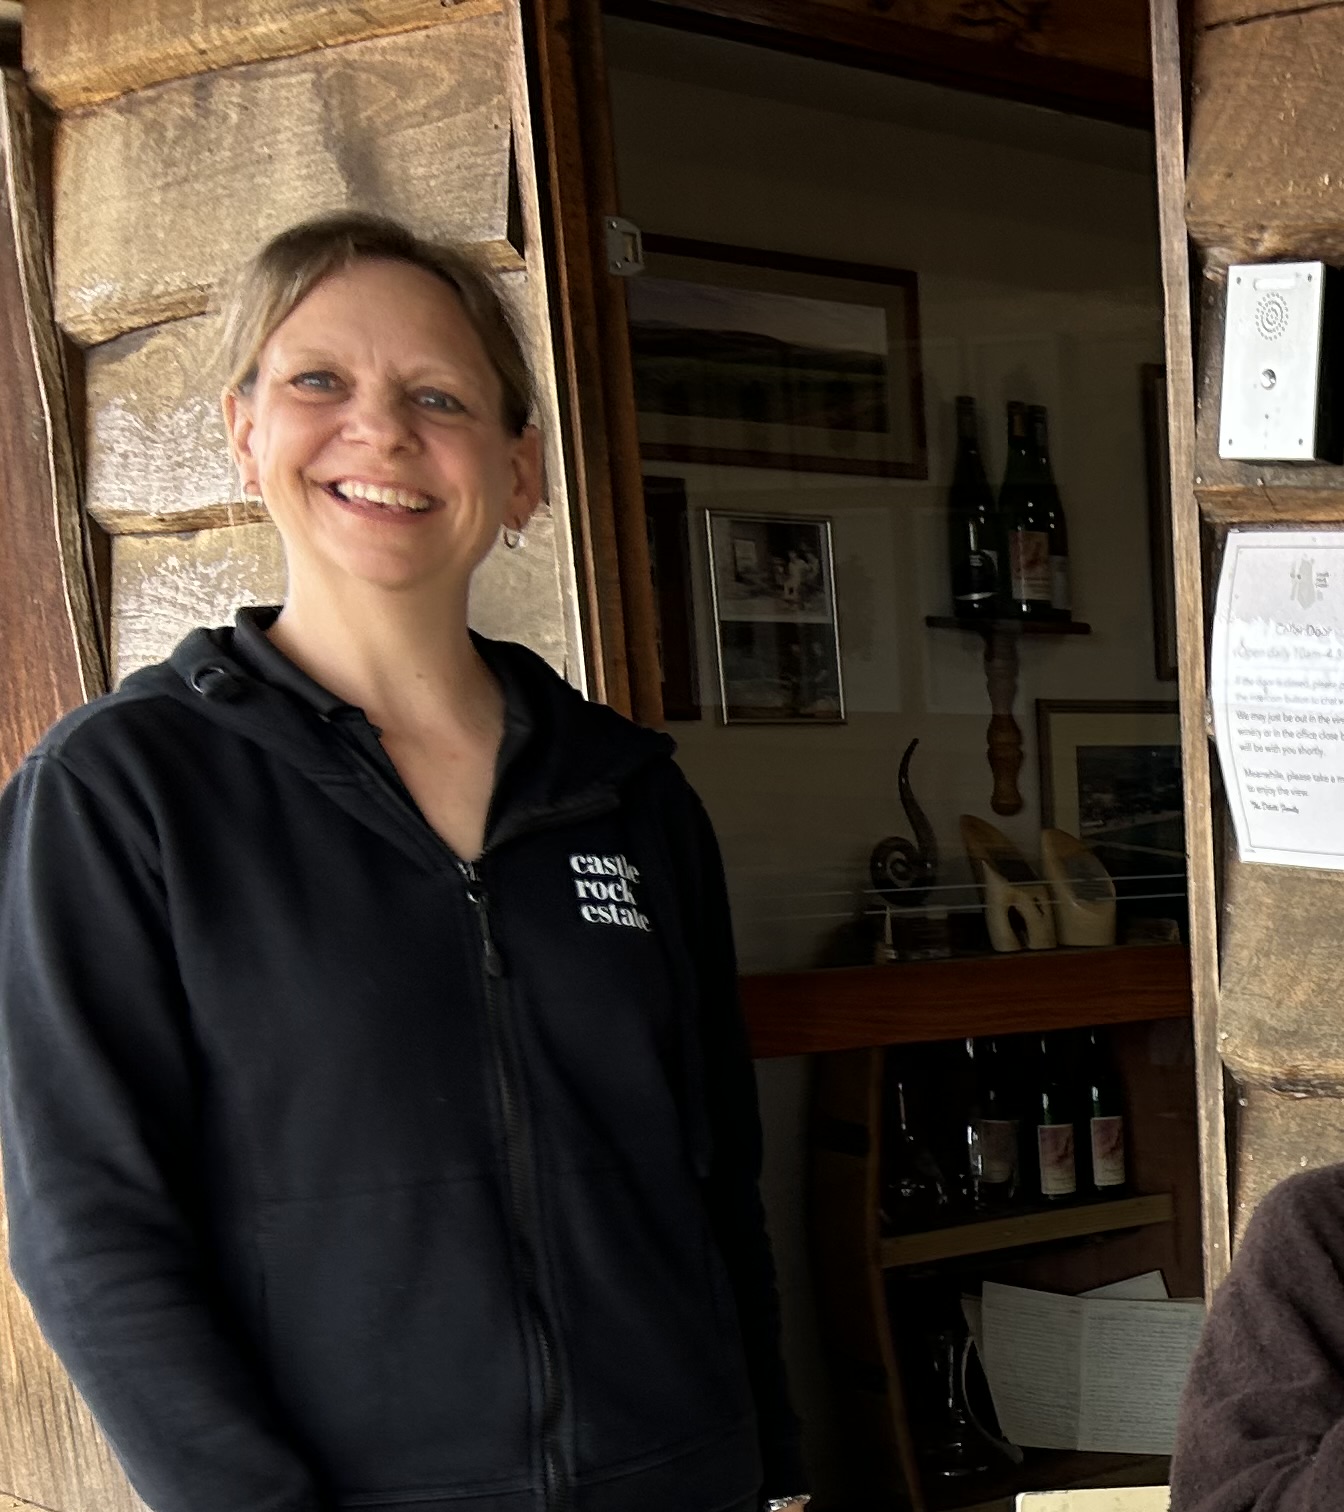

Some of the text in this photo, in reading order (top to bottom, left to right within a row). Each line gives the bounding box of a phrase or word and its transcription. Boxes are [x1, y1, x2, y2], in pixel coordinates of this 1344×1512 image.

[570, 854, 640, 884] castle
[574, 877, 637, 906] rock
[581, 903, 652, 931] estate
